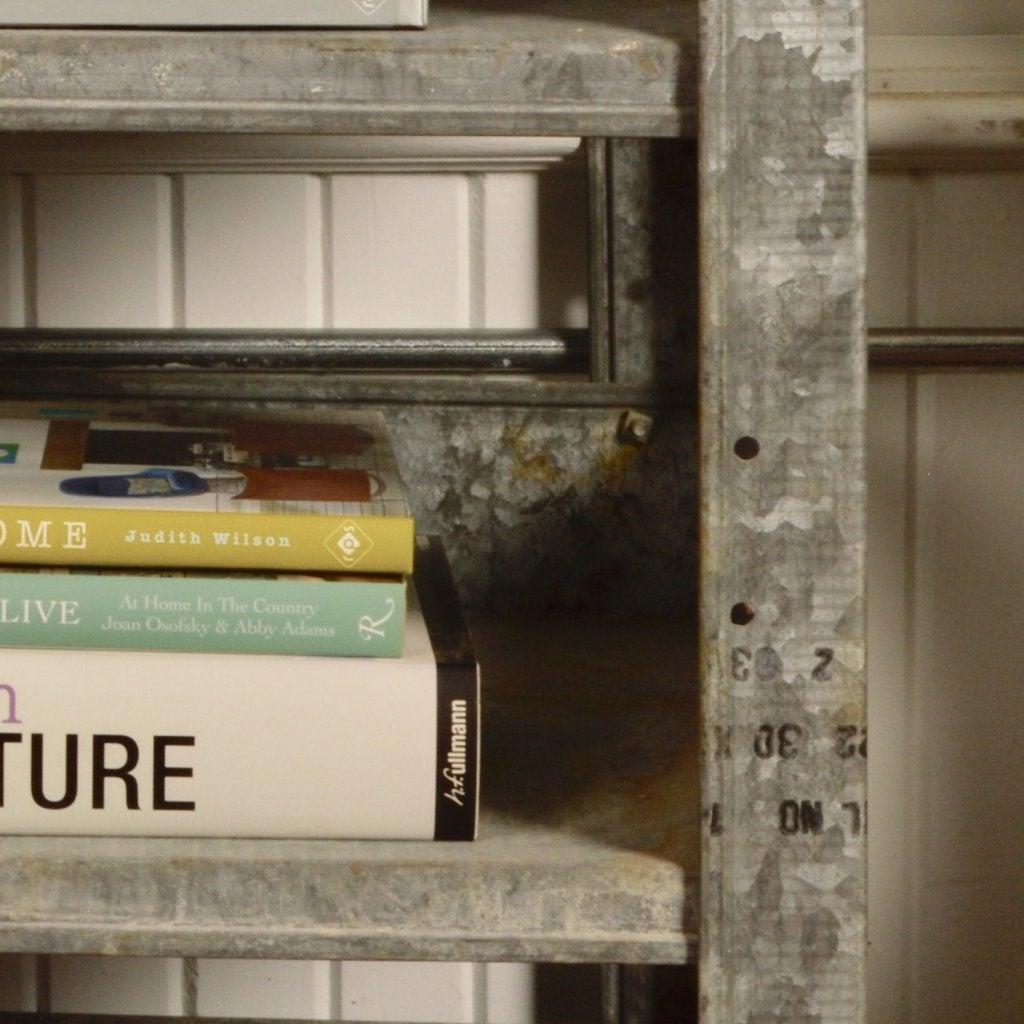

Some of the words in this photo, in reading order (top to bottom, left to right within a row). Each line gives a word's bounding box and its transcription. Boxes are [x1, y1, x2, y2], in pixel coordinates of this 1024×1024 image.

[125, 529, 201, 545] Judith
[213, 532, 292, 547] Wilson
[0, 599, 81, 625] LIVE
[120, 595, 139, 611] At
[143, 595, 192, 613] Home
[196, 598, 213, 613] In
[218, 597, 249, 614] The
[253, 598, 319, 618] Country
[101, 616, 141, 632] Joan
[146, 617, 212, 636] Osofsky
[216, 620, 230, 633] &
[234, 619, 277, 638] Abby
[281, 621, 336, 638] Adams
